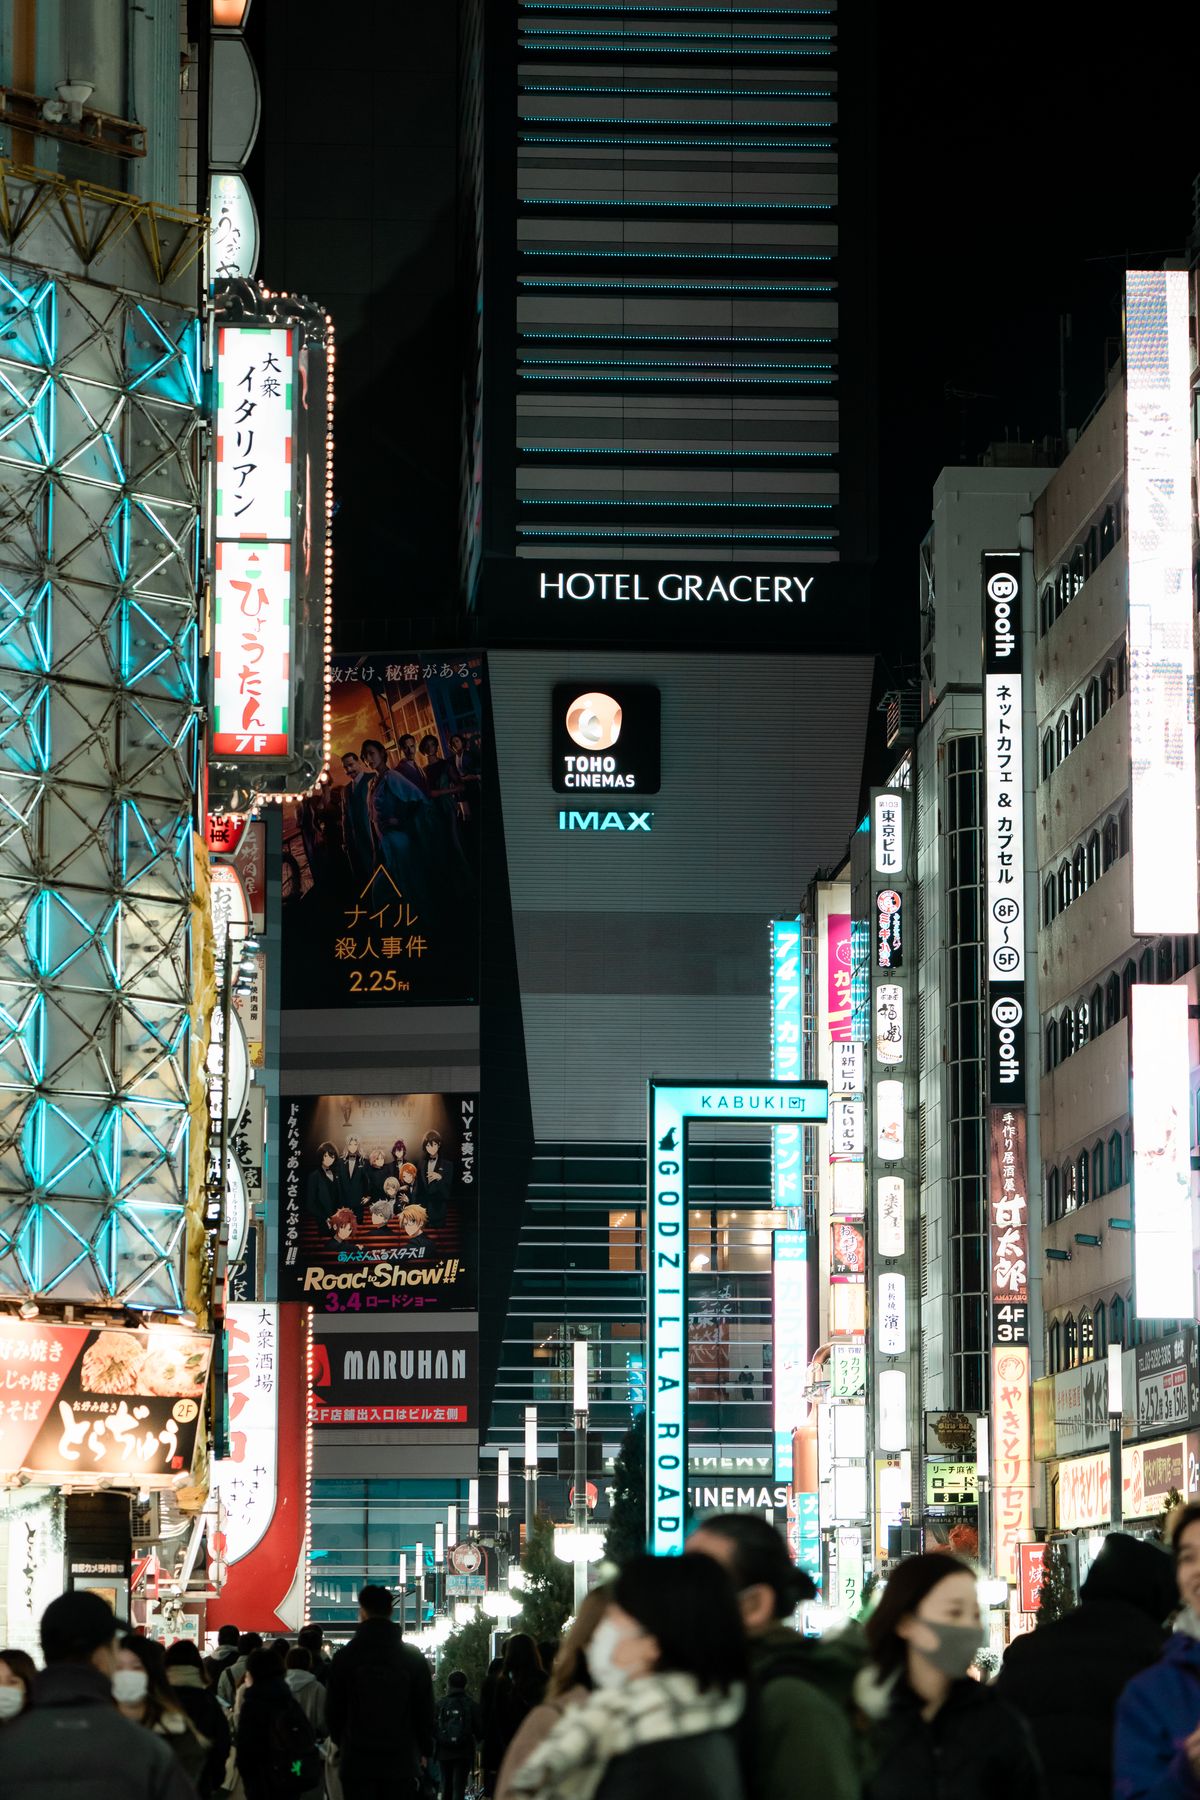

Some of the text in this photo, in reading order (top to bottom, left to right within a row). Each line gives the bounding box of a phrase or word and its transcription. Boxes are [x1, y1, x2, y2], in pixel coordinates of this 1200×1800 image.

[259, 352, 282, 398] 大衆
[232, 366, 258, 518] イタリアン
[540, 573, 815, 603] HOTEL GRACERY
[987, 572, 1018, 657] Booth
[228, 579, 271, 731] ひょうたん
[235, 735, 268, 752] 7F
[564, 756, 616, 773] TOHO
[564, 774, 635, 788] CINEMAS
[996, 685, 1014, 884] ネットカフェ & カプセル
[558, 811, 653, 831] IMAX
[881, 810, 896, 866] 東京ビル
[343, 903, 419, 929] ナイル
[998, 905, 1014, 917] 8F
[334, 935, 428, 959] 殺人事件
[998, 953, 1015, 965] 5F
[349, 970, 397, 992] 2.25
[992, 998, 1022, 1083] Booth
[841, 1044, 856, 1091] 川新ビル
[842, 1104, 855, 1151] にいむら
[1001, 1112, 1016, 1192] 手作り居酒屋
[992, 1194, 1027, 1292] 甘太郎
[325, 1292, 438, 1312] 3.4 ロードショー
[997, 1305, 1025, 1323] 4F
[657, 1160, 680, 1533] GODZILLA ROAD
[997, 1324, 1025, 1342] 3F
[255, 1308, 274, 1392] 大衆酒場
[343, 1349, 467, 1380] MARUHAN
[73, 1400, 118, 1413] お好み焼き
[177, 1406, 194, 1419] 2F
[58, 1400, 180, 1462] とらぢゅう
[932, 1476, 975, 1490] ロード
[933, 1465, 975, 1474] リーチ麻雀
